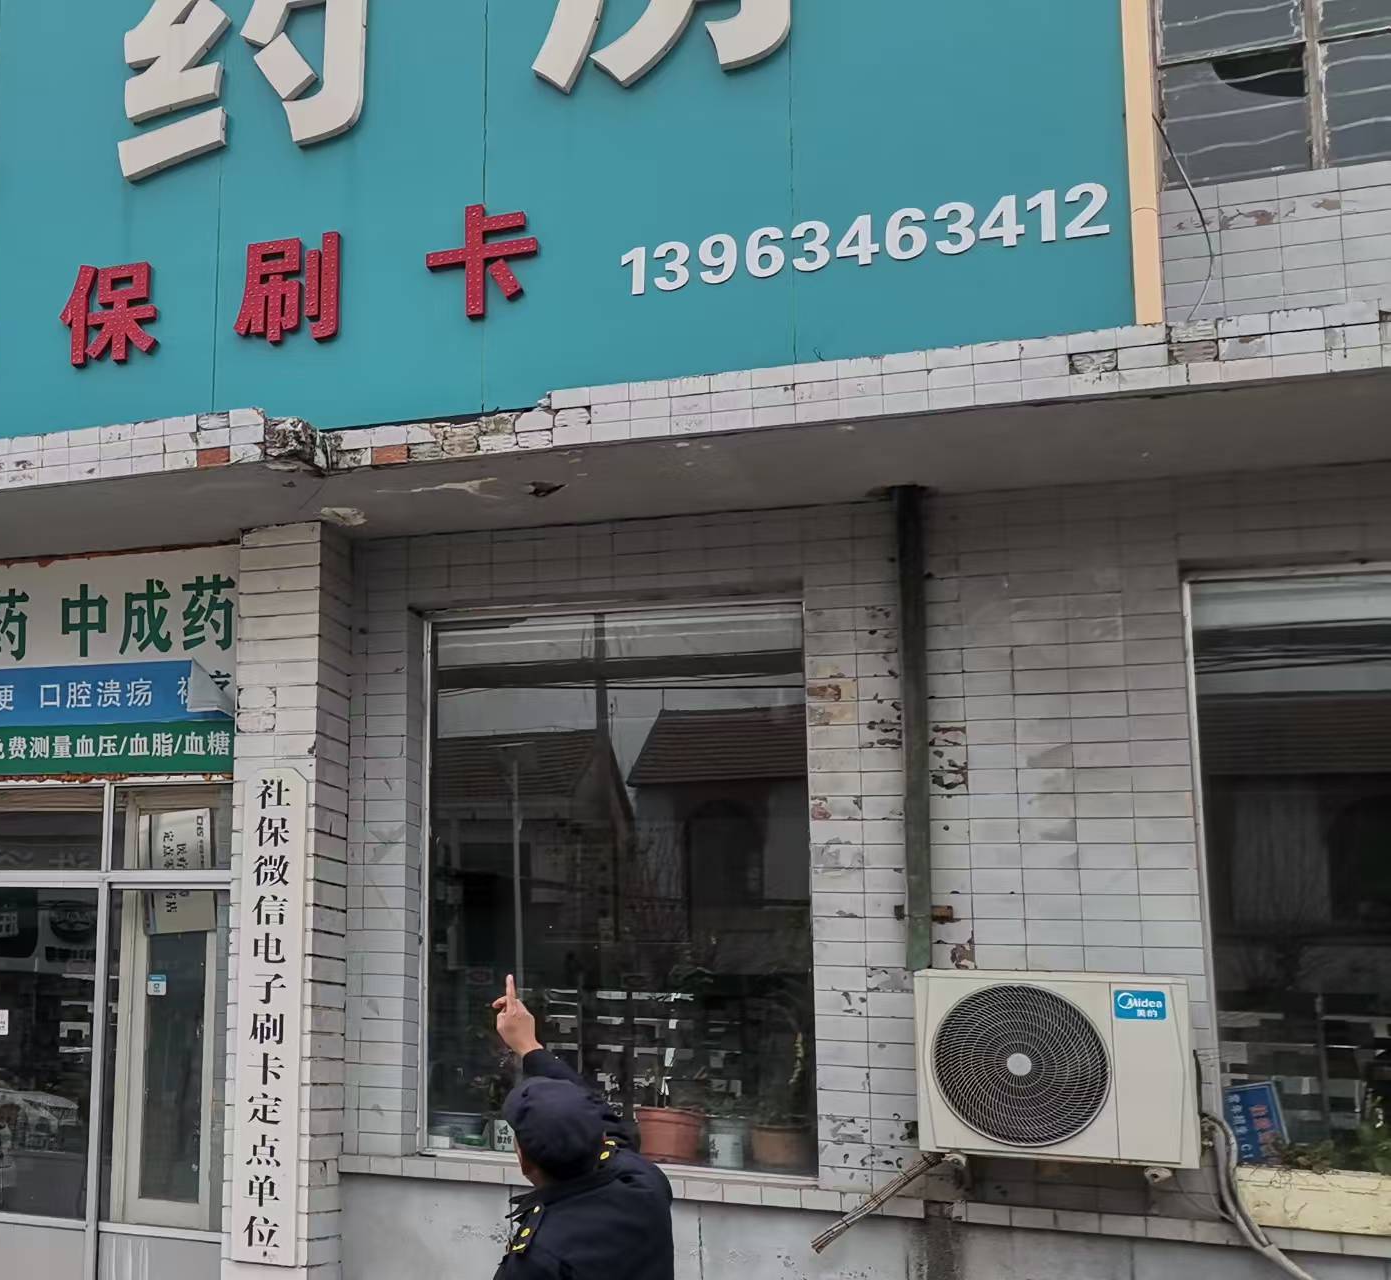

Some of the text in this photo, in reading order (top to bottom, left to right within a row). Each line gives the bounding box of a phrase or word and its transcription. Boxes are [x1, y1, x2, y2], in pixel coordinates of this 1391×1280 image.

[620, 182, 1111, 297] 13963463412
[61, 574, 235, 659] 中成药
[39, 677, 153, 708] 口腔溃疡
[242, 777, 291, 1248] 社保微信电子刷卡定点单位
[1121, 994, 1163, 1009] Midea
